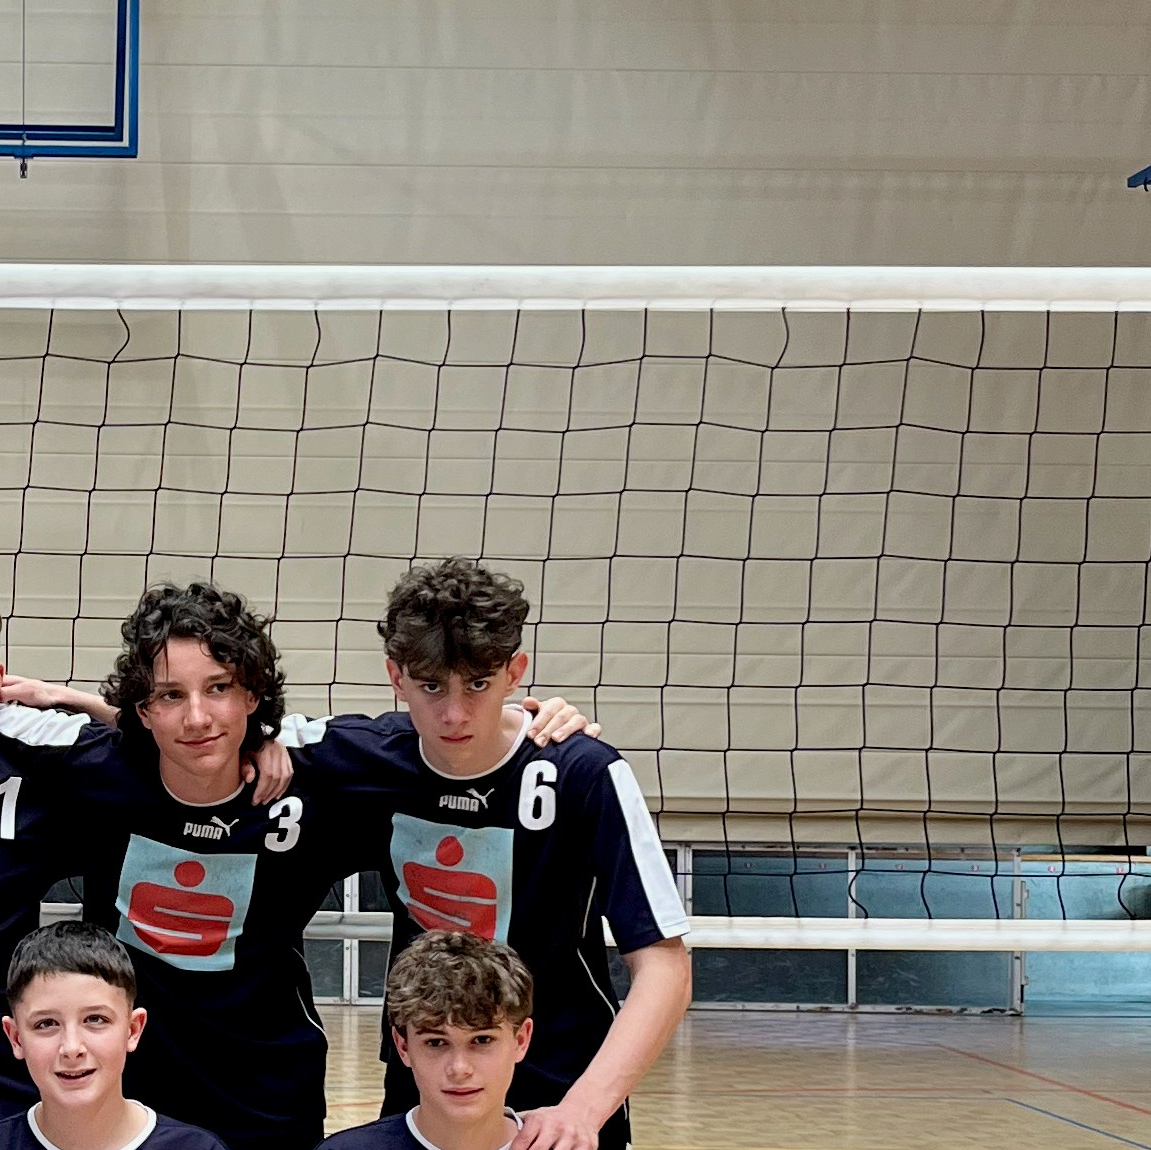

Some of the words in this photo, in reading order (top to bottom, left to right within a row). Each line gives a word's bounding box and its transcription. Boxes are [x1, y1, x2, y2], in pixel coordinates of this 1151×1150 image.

[439, 794, 479, 812] PUMA
[517, 759, 556, 831] 6
[183, 821, 223, 840] PUMA
[264, 796, 303, 852] 3
